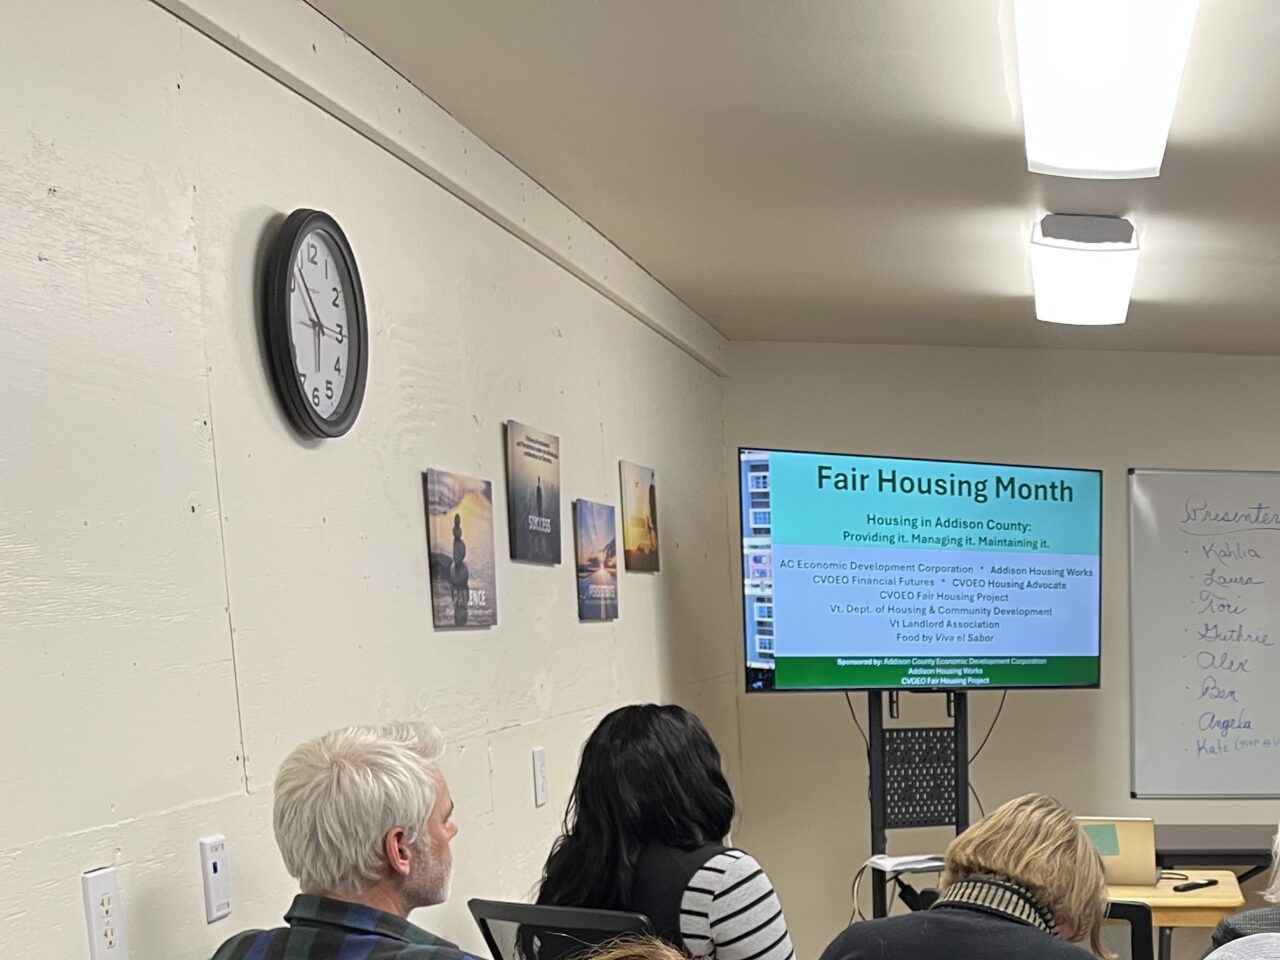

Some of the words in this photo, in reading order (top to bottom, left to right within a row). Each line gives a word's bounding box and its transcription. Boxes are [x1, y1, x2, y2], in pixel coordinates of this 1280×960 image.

[307, 241, 318, 265] 12
[332, 287, 340, 308] 2
[335, 323, 344, 344] 3
[334, 356, 341, 375] 4
[312, 387, 320, 407] 6
[325, 380, 334, 400] 5
[817, 465, 870, 491] Fair
[878, 469, 988, 504] Housing
[995, 476, 1073, 502] Month
[867, 514, 918, 529] Housing
[921, 516, 932, 527] in
[935, 517, 984, 529] Addison
[986, 519, 1032, 533] County:
[843, 531, 896, 545] Providing
[897, 533, 909, 543] it.
[911, 534, 963, 547] Managing
[965, 536, 976, 546] it.
[978, 536, 1038, 550] Maintaining
[1040, 539, 1050, 548] it.
[1202, 542, 1263, 567] Kahlia
[780, 560, 795, 569] AC
[797, 560, 848, 570] Economic
[850, 562, 915, 572] Development
[917, 563, 974, 574] Corporation
[990, 566, 1027, 575] Addison
[1029, 567, 1065, 578] Housing
[1066, 568, 1093, 577] Works
[812, 575, 849, 584] CVOEO
[851, 576, 896, 585] Financial
[899, 577, 935, 586] Futures
[952, 579, 986, 588] CVOEO
[988, 580, 1025, 590] Housing
[1026, 580, 1067, 589] Advocate
[879, 591, 914, 600] CVOEO
[917, 591, 934, 600] Fair
[936, 592, 974, 602] Housing
[976, 593, 1009, 602] Project
[1197, 589, 1247, 614] Tori
[830, 604, 844, 613] Vt.
[846, 605, 872, 615] Dept.
[875, 605, 885, 614] of
[888, 605, 926, 615] Housing
[929, 606, 936, 614] &
[938, 606, 991, 617] Community
[993, 607, 1052, 617] Development
[890, 619, 900, 628] Vt
[902, 619, 944, 629] Landlord
[946, 620, 1000, 629] Association
[896, 633, 920, 642] Food
[922, 633, 933, 644] by
[935, 634, 955, 642] Viva
[967, 634, 994, 642] Sabor
[1198, 675, 1239, 703] Ben
[1198, 708, 1253, 738] Angela
[1196, 739, 1230, 760] Kate
